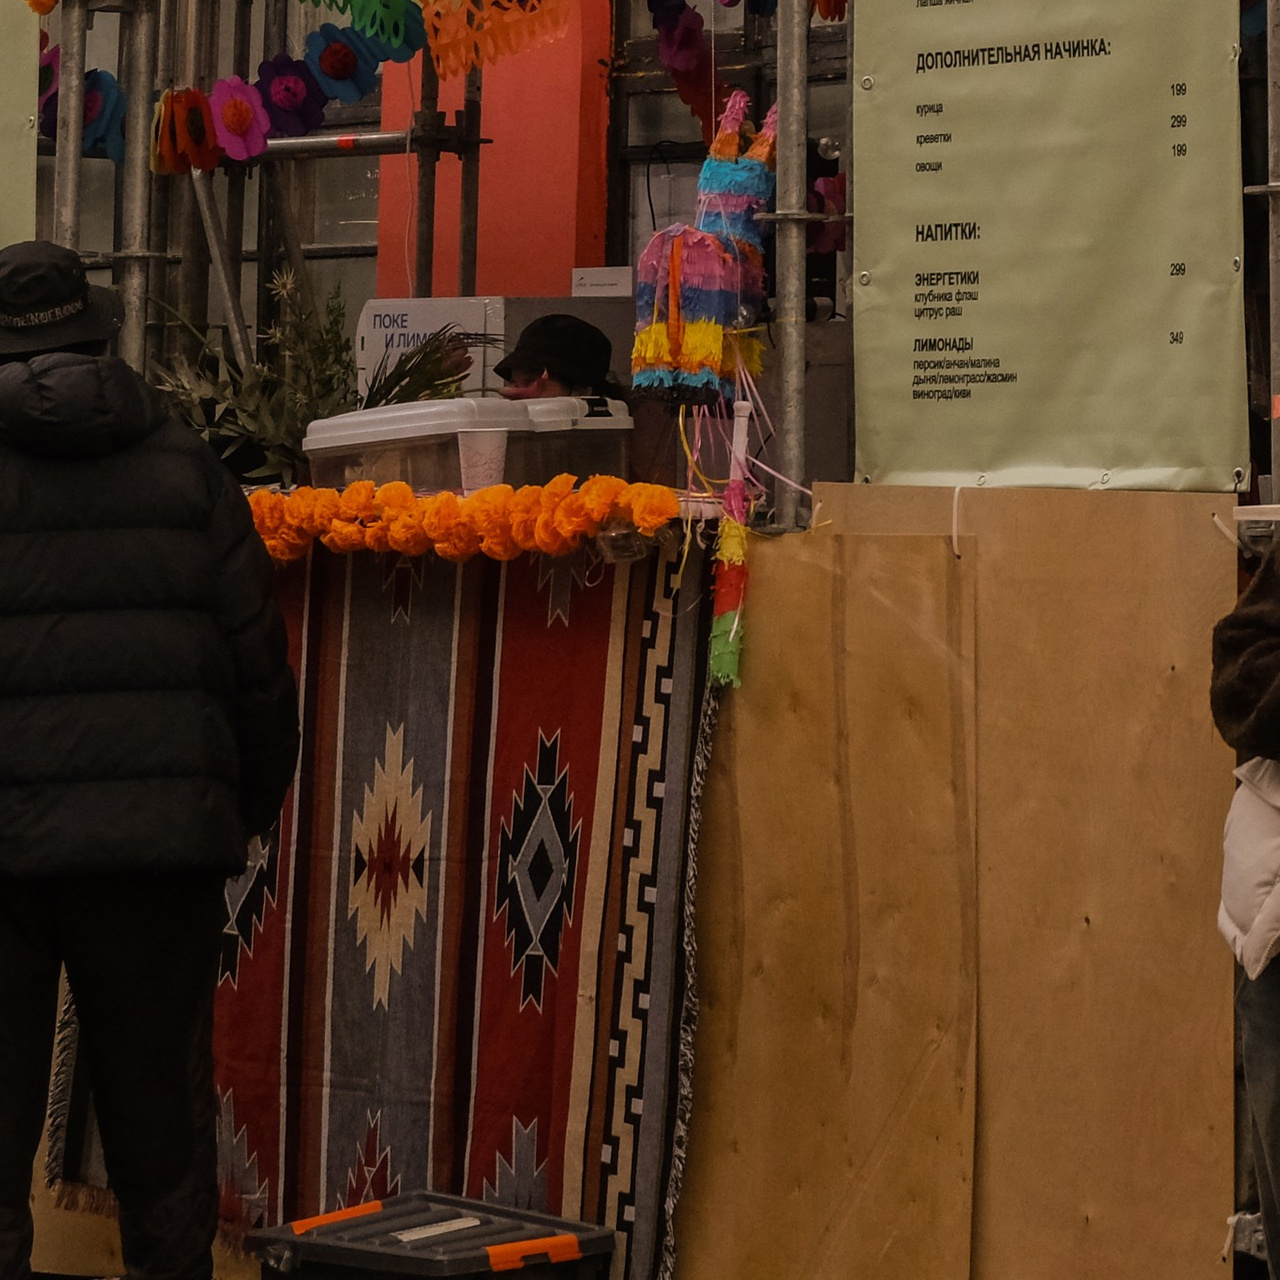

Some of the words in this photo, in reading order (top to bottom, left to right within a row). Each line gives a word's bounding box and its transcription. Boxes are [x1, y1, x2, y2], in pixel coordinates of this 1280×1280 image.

[916, 44, 1040, 73] ДОПОЛНИТЕЛЬНАЯ
[1044, 38, 1111, 61] НАЧИНКА:
[1171, 83, 1187, 96] 199
[916, 102, 943, 116] курица
[1171, 114, 1187, 128] 299
[916, 132, 952, 147] креветки
[1172, 143, 1187, 157] 199
[915, 161, 942, 174] овощи
[915, 223, 981, 242] НАПИТКИ:
[1170, 263, 1186, 276] 299
[915, 271, 979, 287] ЭНЕРГЕТИКИ
[914, 290, 952, 305] клубника
[955, 289, 978, 304] флэш
[914, 307, 944, 320] цитрус
[945, 306, 962, 319] раш
[373, 313, 408, 329] ПОКЕ
[913, 337, 973, 353] ЛИМОНАДЫ
[1169, 331, 1184, 345] 349
